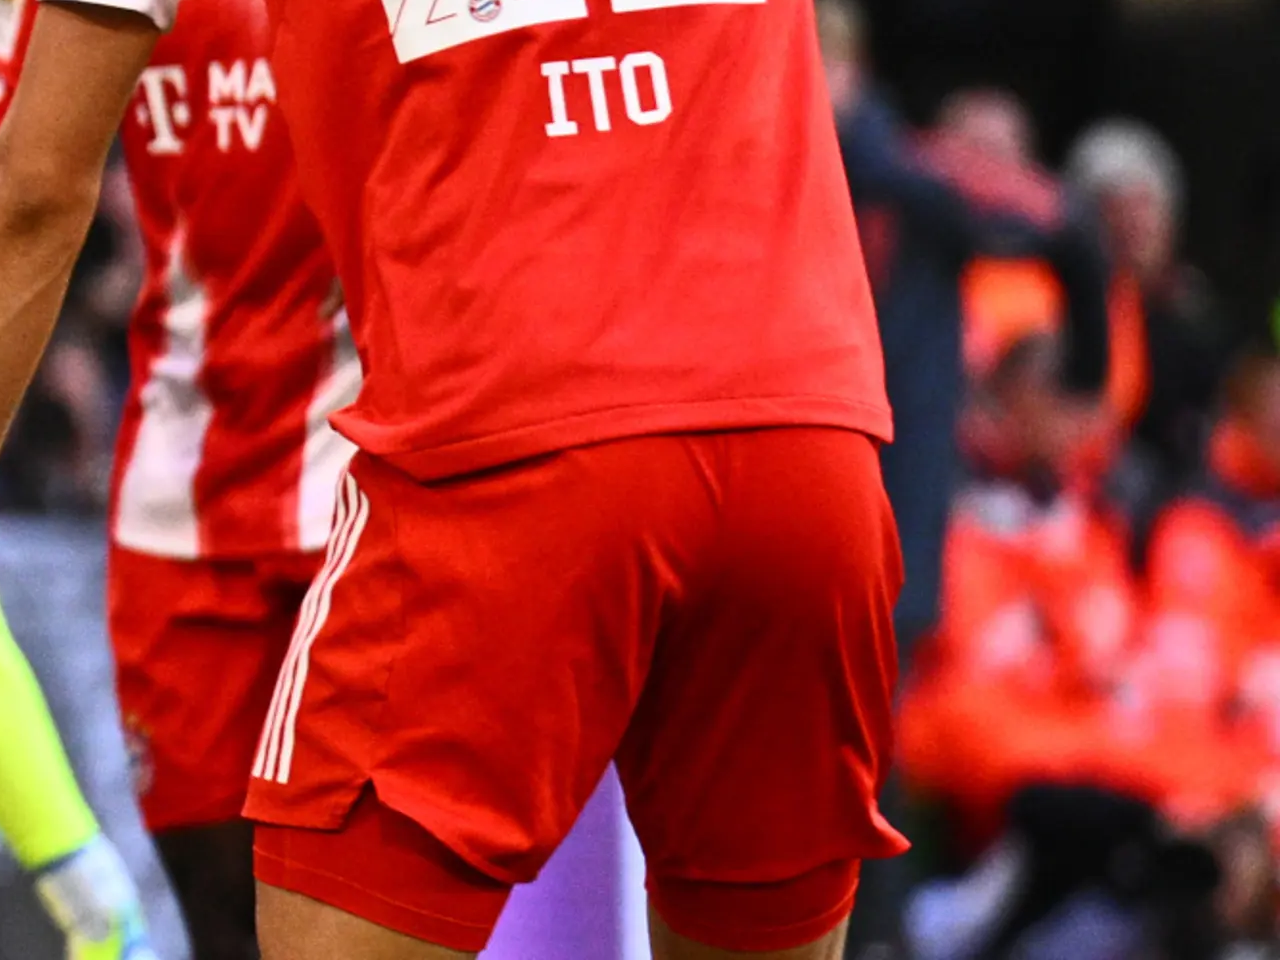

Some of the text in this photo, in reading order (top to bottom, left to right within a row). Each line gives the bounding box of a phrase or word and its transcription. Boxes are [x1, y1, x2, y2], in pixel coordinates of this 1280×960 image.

[208, 56, 278, 105] MA
[540, 51, 673, 137] ITO
[209, 102, 268, 153] TV
